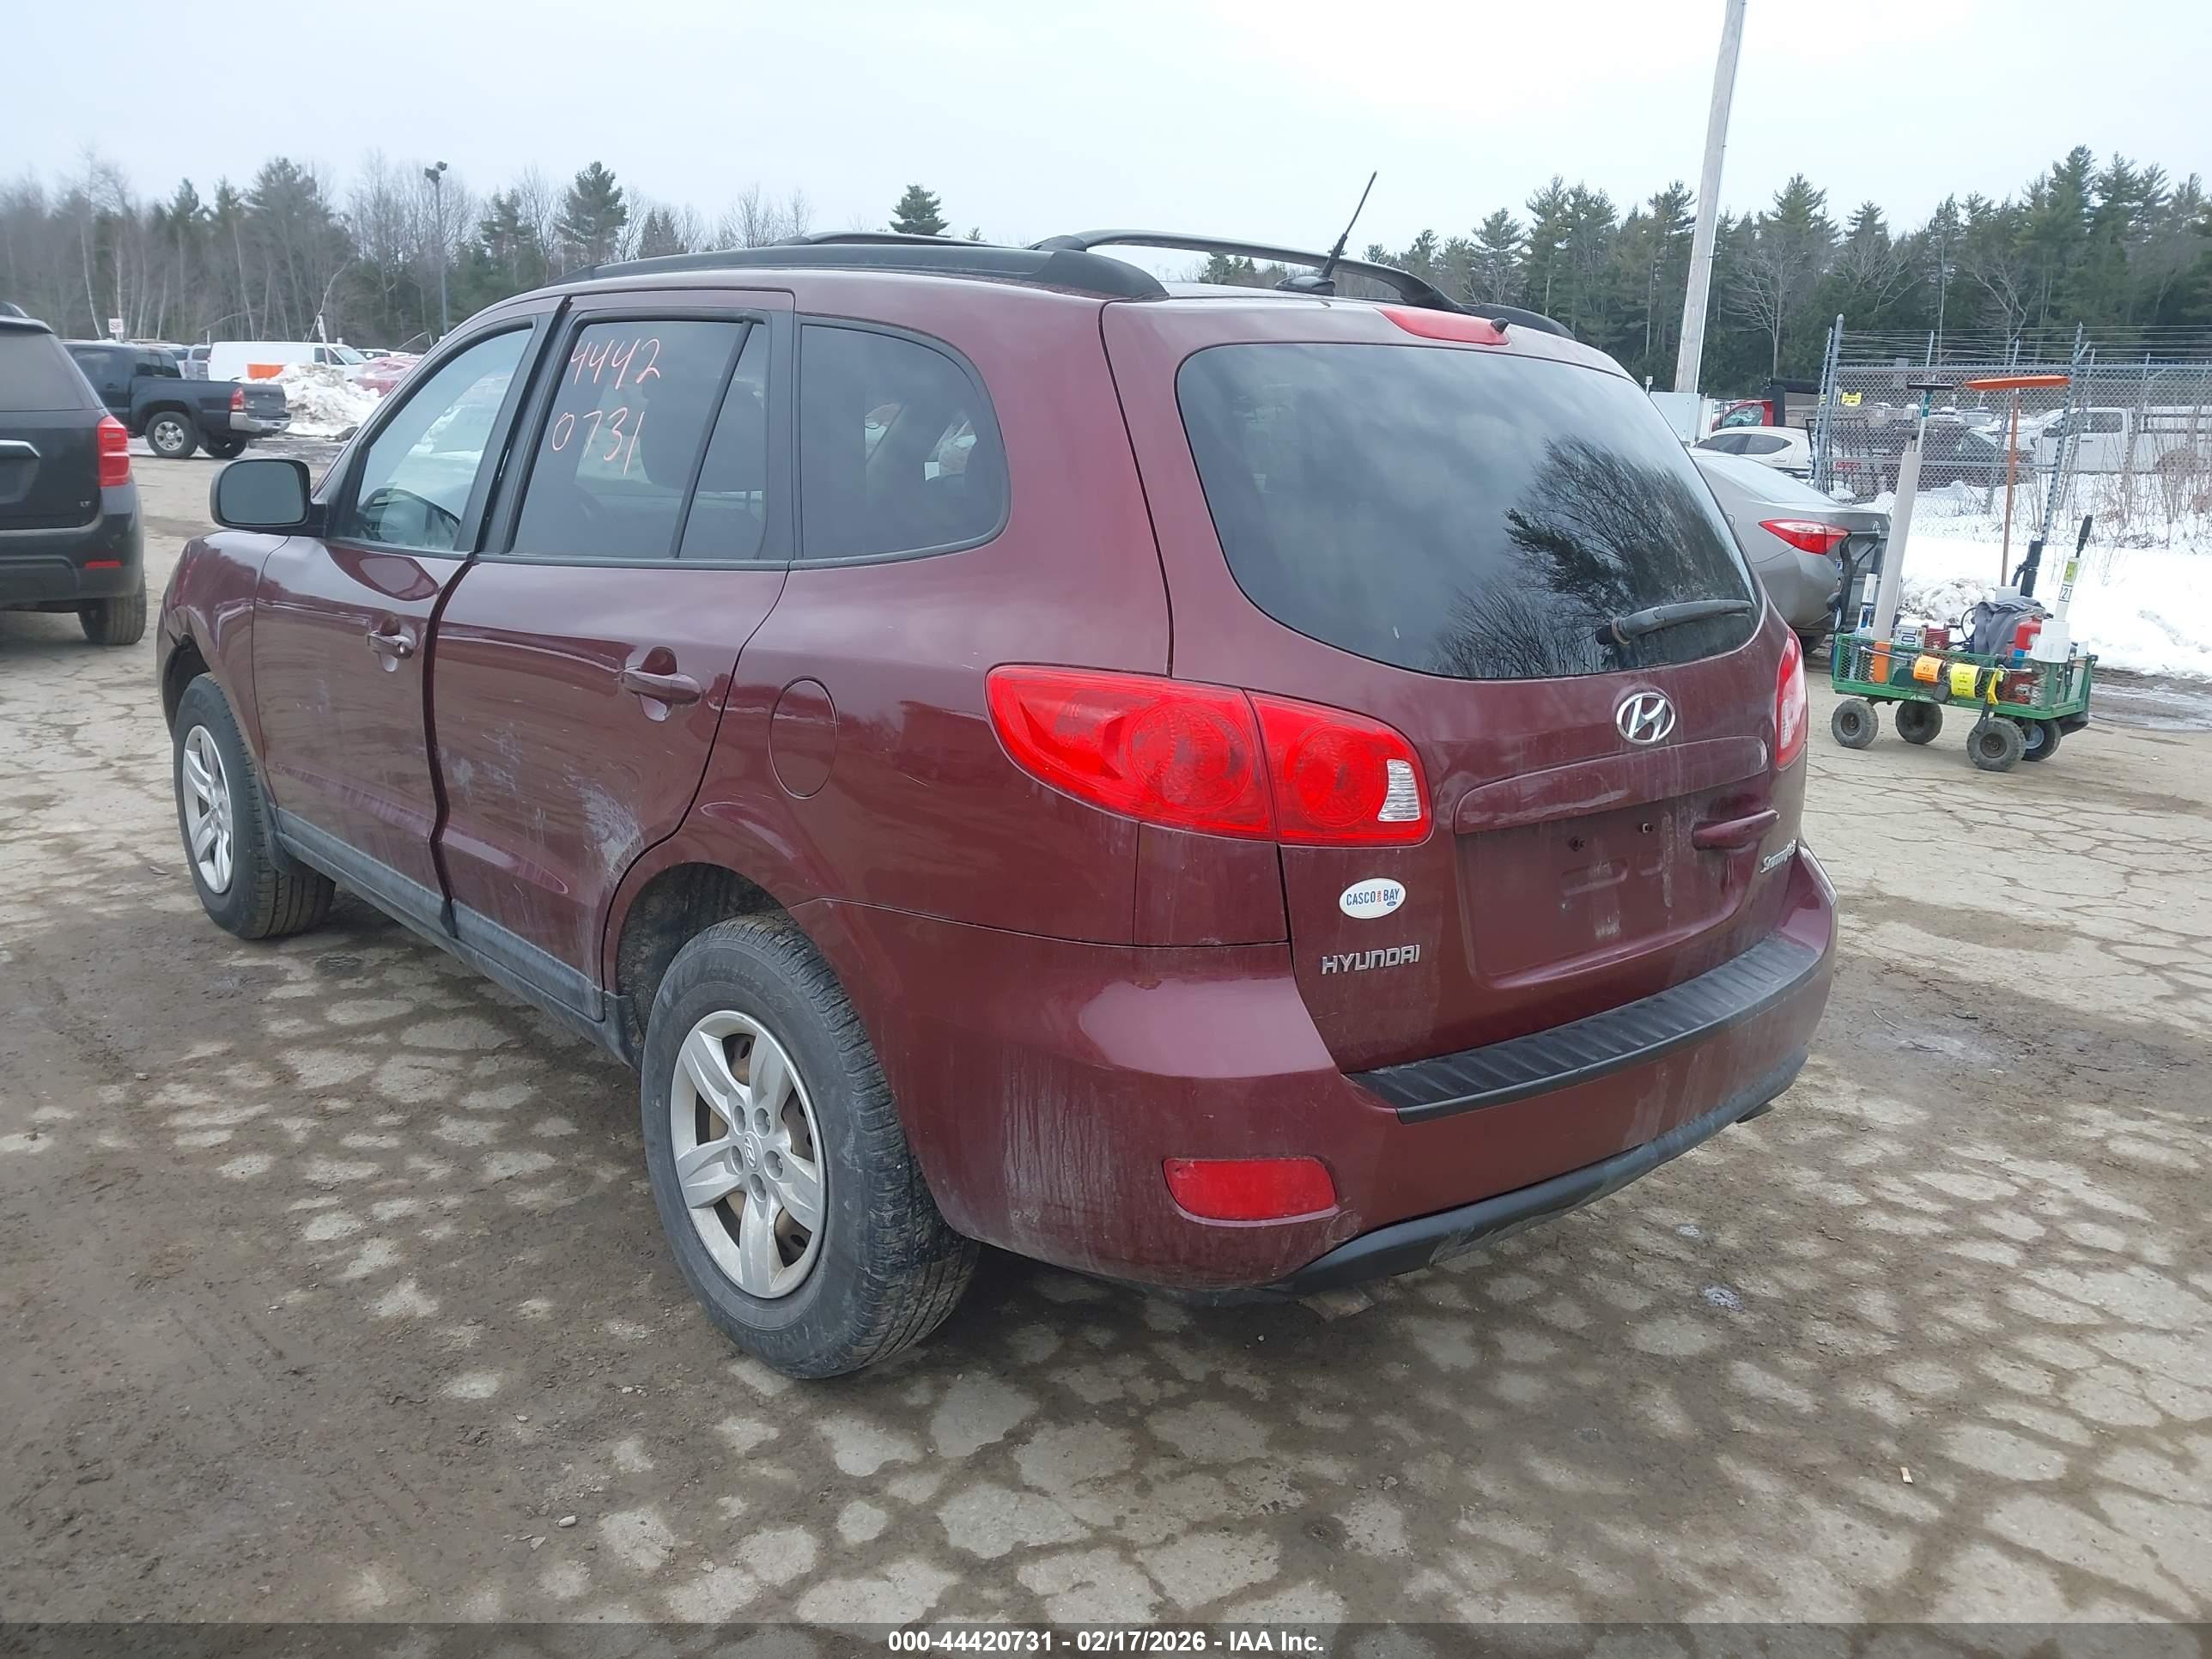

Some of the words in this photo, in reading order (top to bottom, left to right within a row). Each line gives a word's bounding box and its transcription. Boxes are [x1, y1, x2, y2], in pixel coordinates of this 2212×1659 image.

[570, 338, 660, 389] 4442
[552, 407, 645, 476] 0731
[1346, 890, 1376, 906] CASCO
[1383, 888, 1400, 902] BAY
[1322, 945, 1421, 975] HYUNDAI
